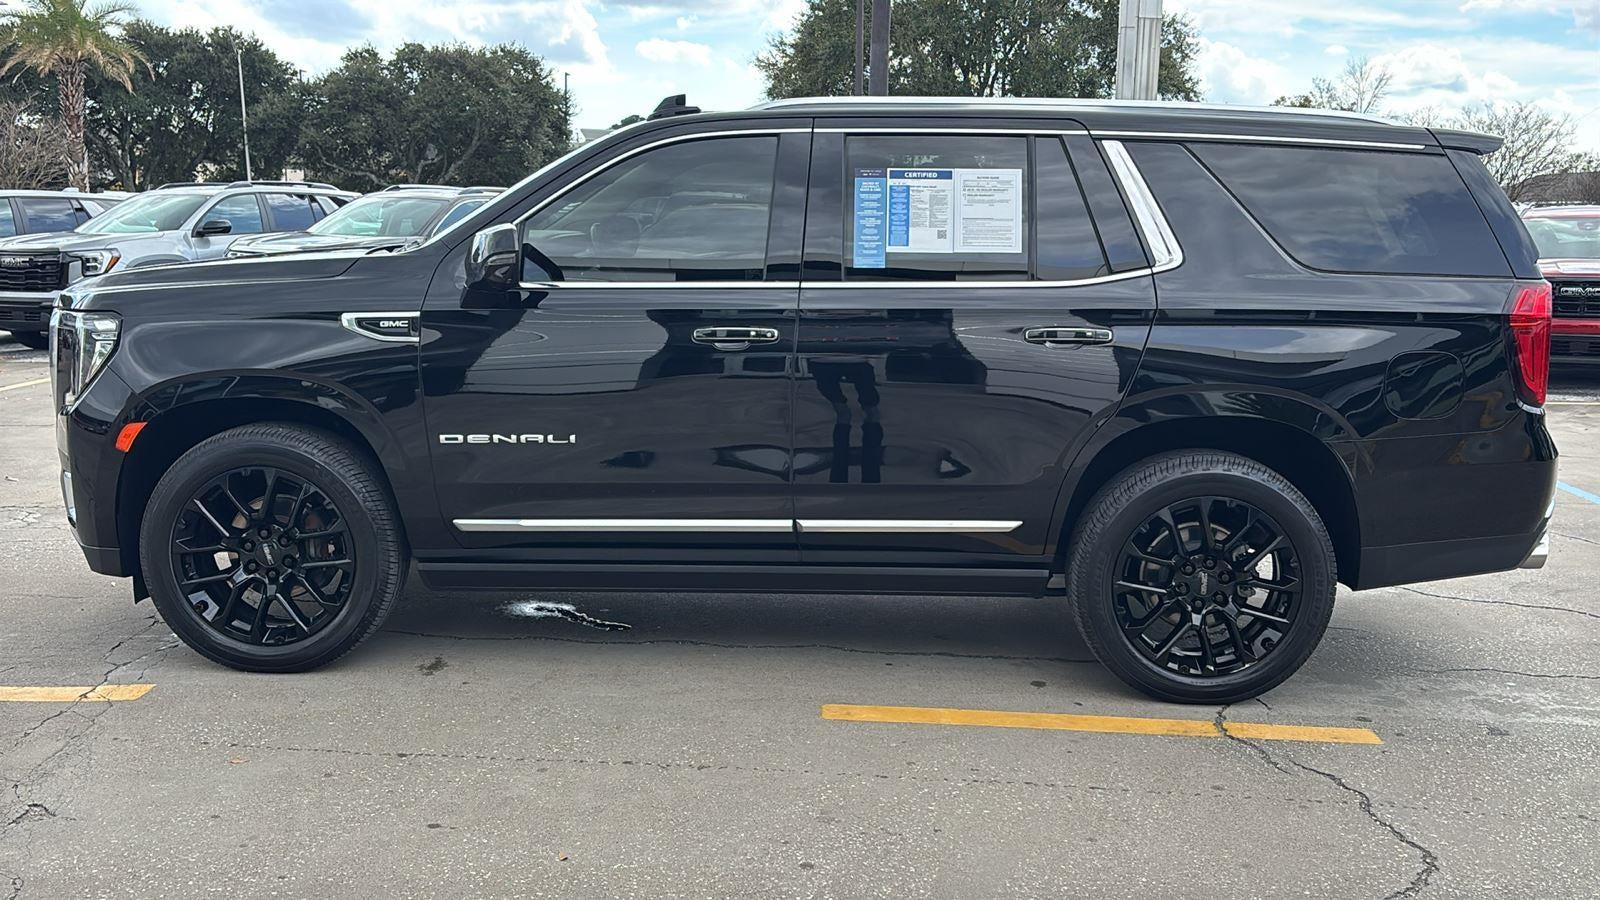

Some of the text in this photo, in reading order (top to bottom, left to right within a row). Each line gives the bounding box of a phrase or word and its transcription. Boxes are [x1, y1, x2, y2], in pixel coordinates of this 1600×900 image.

[0, 257, 29, 267] GMC
[379, 320, 409, 328] GMC
[439, 434, 576, 444] DENALI
